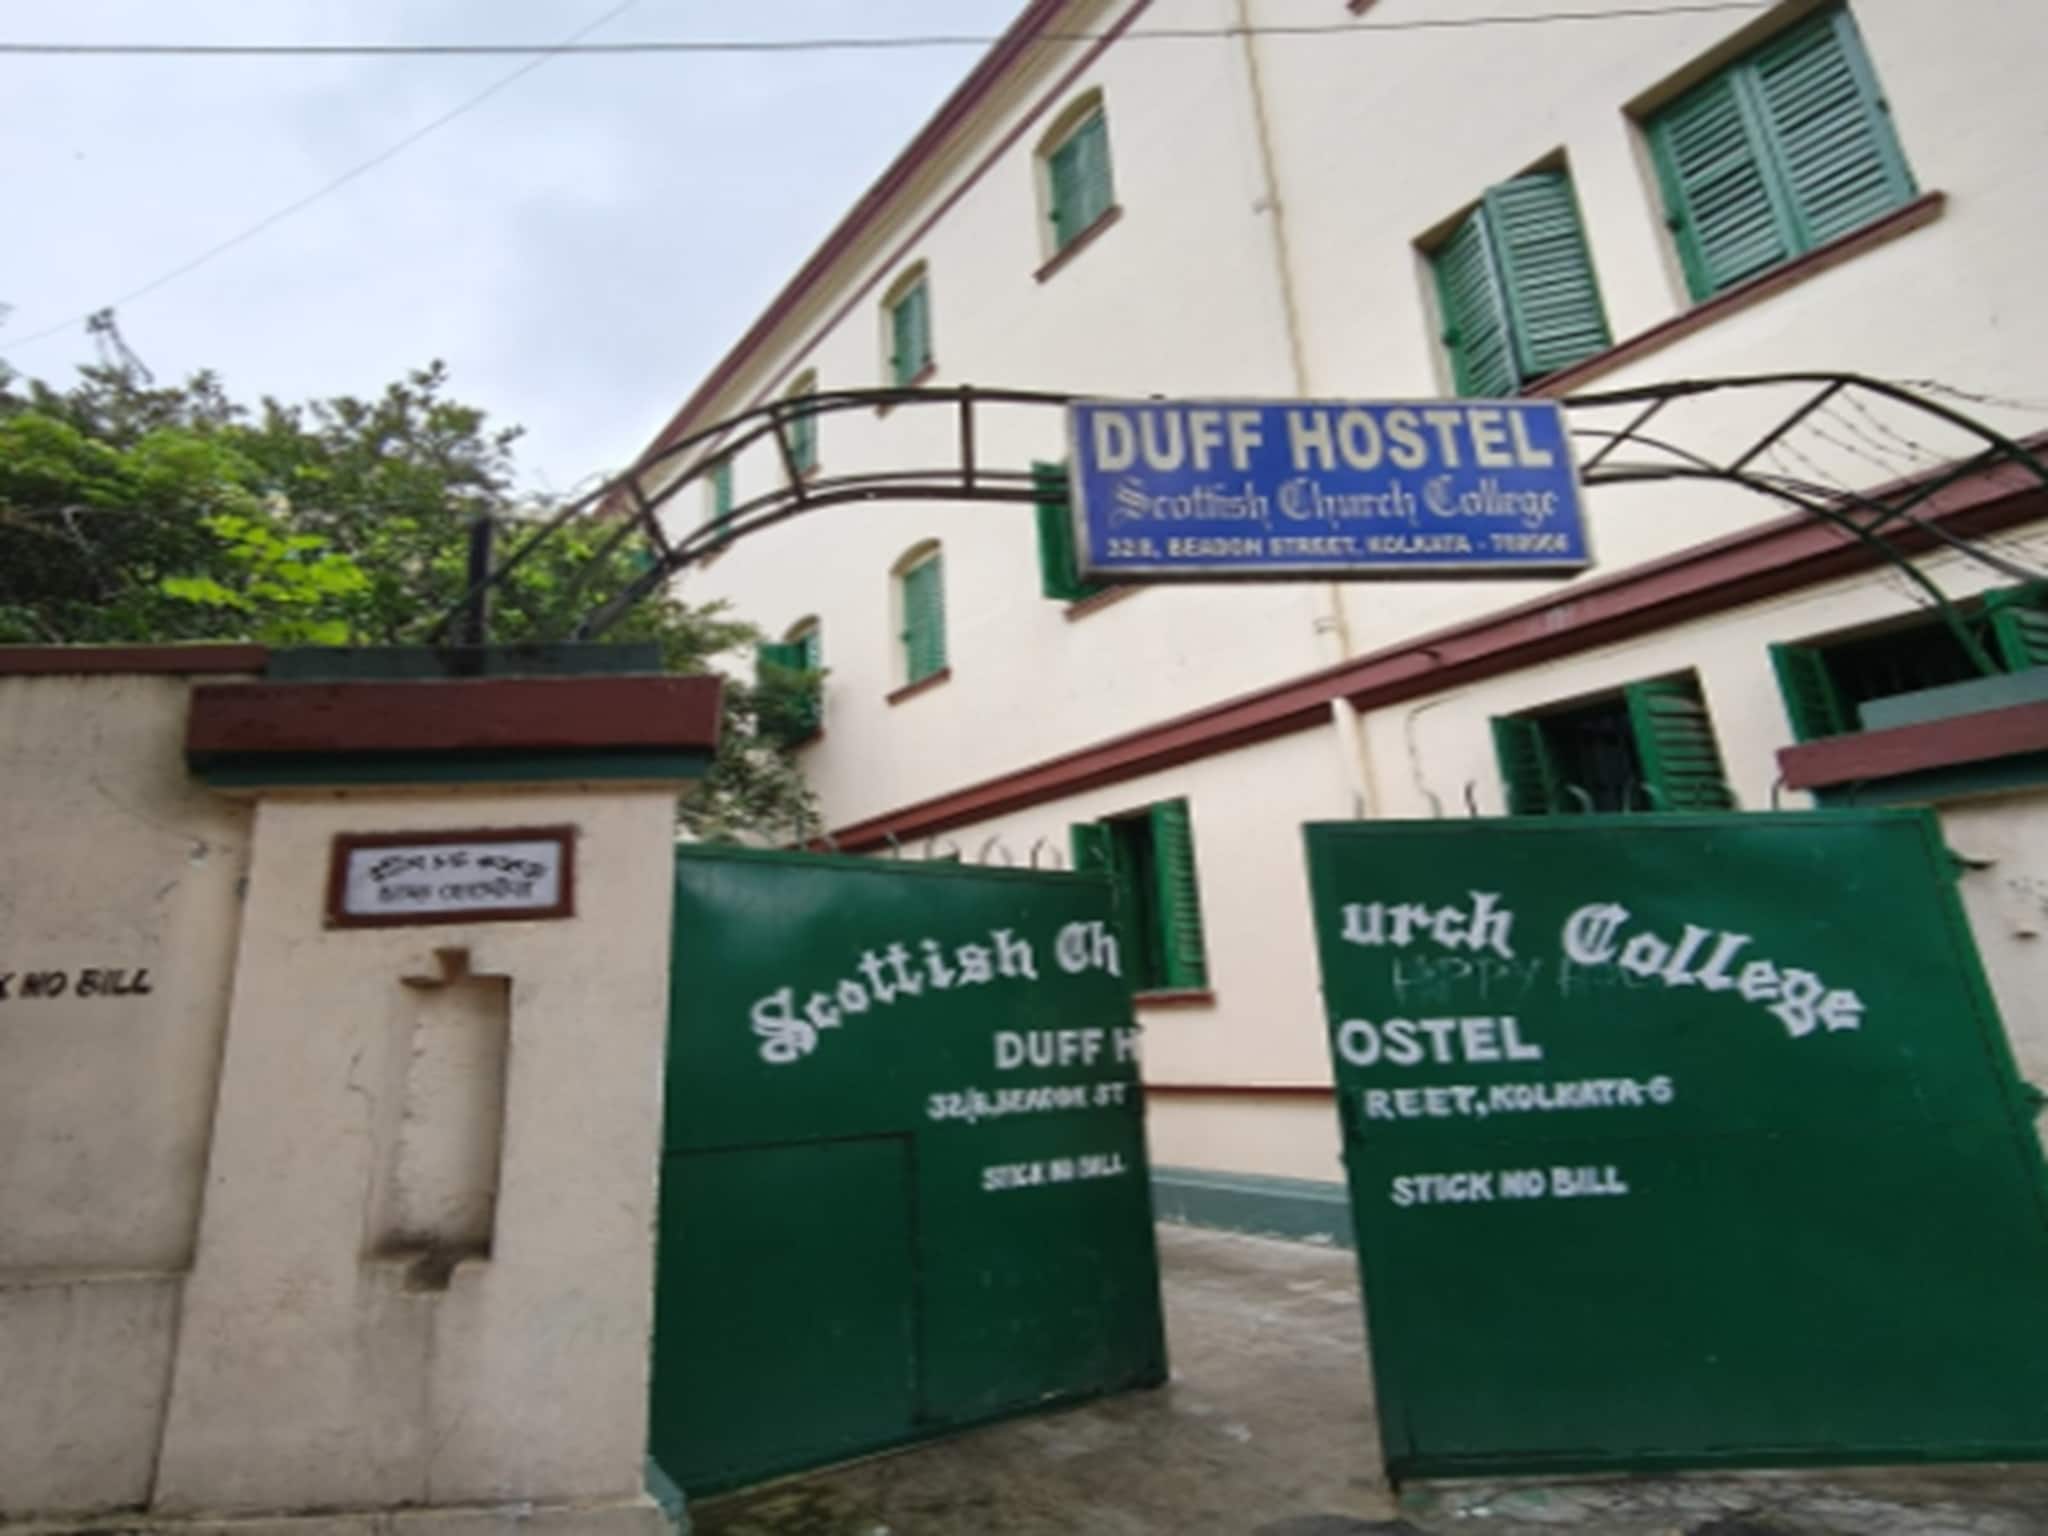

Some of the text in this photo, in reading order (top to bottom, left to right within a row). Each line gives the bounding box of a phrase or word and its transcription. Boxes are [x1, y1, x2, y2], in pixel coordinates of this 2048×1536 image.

[1096, 406, 1554, 472] DUFF HOSTEL
[1108, 474, 1560, 531] Scottish Church College
[19, 970, 68, 999] NO
[75, 967, 154, 998] BILL
[1340, 890, 1515, 958] urch
[1561, 902, 1866, 1038] College
[749, 919, 1122, 1064] Scottish Ch
[994, 1026, 1104, 1070] DUFF
[1337, 1016, 1542, 1066] OSTEL
[1390, 1164, 1630, 1207] STICK NO BILL
